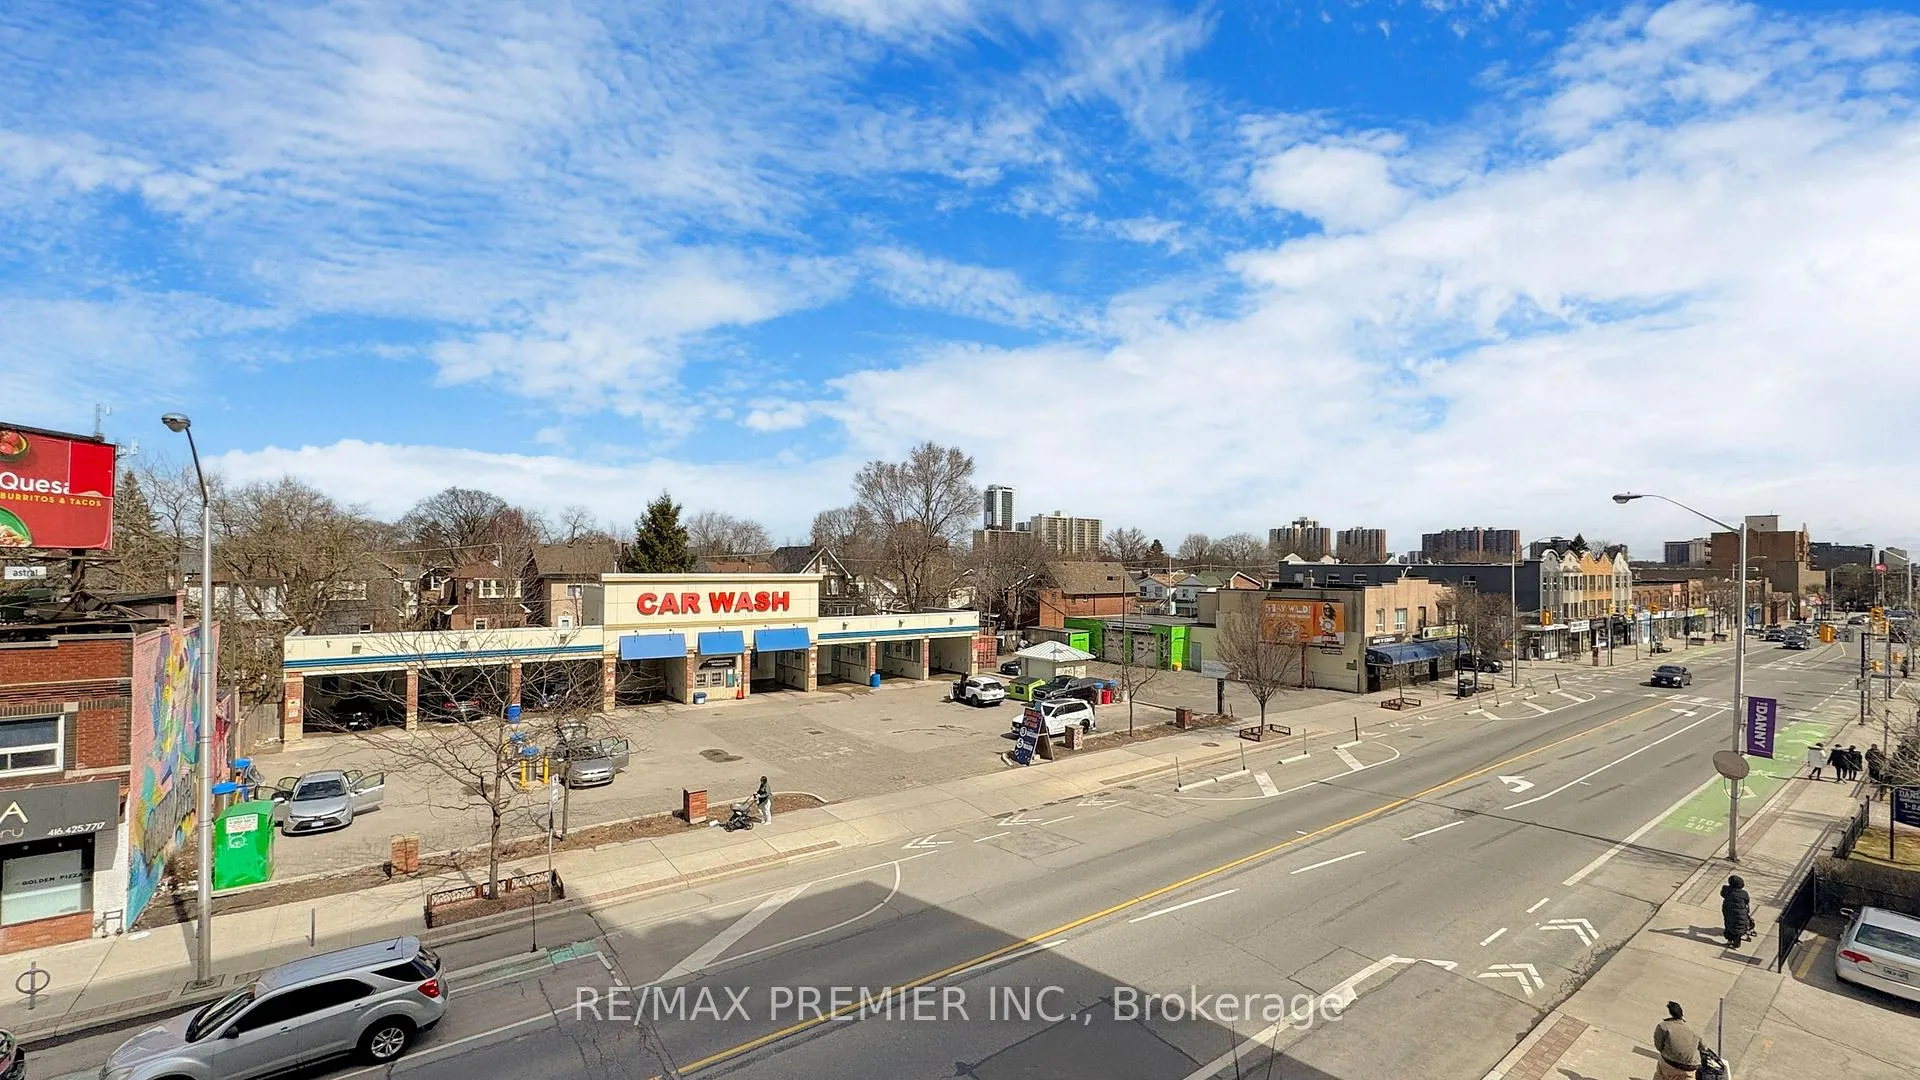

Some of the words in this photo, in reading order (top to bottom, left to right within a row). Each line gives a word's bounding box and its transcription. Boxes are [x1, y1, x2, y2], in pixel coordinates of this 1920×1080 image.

[0, 491, 54, 503] BURRITOS
[70, 498, 102, 507] TACOS
[13, 569, 38, 577] astral
[637, 592, 701, 615] CAR
[709, 591, 790, 613] WASH
[1754, 705, 1768, 749] DANNY
[22, 877, 55, 886] GOLDEN
[60, 872, 83, 880] PIZZA
